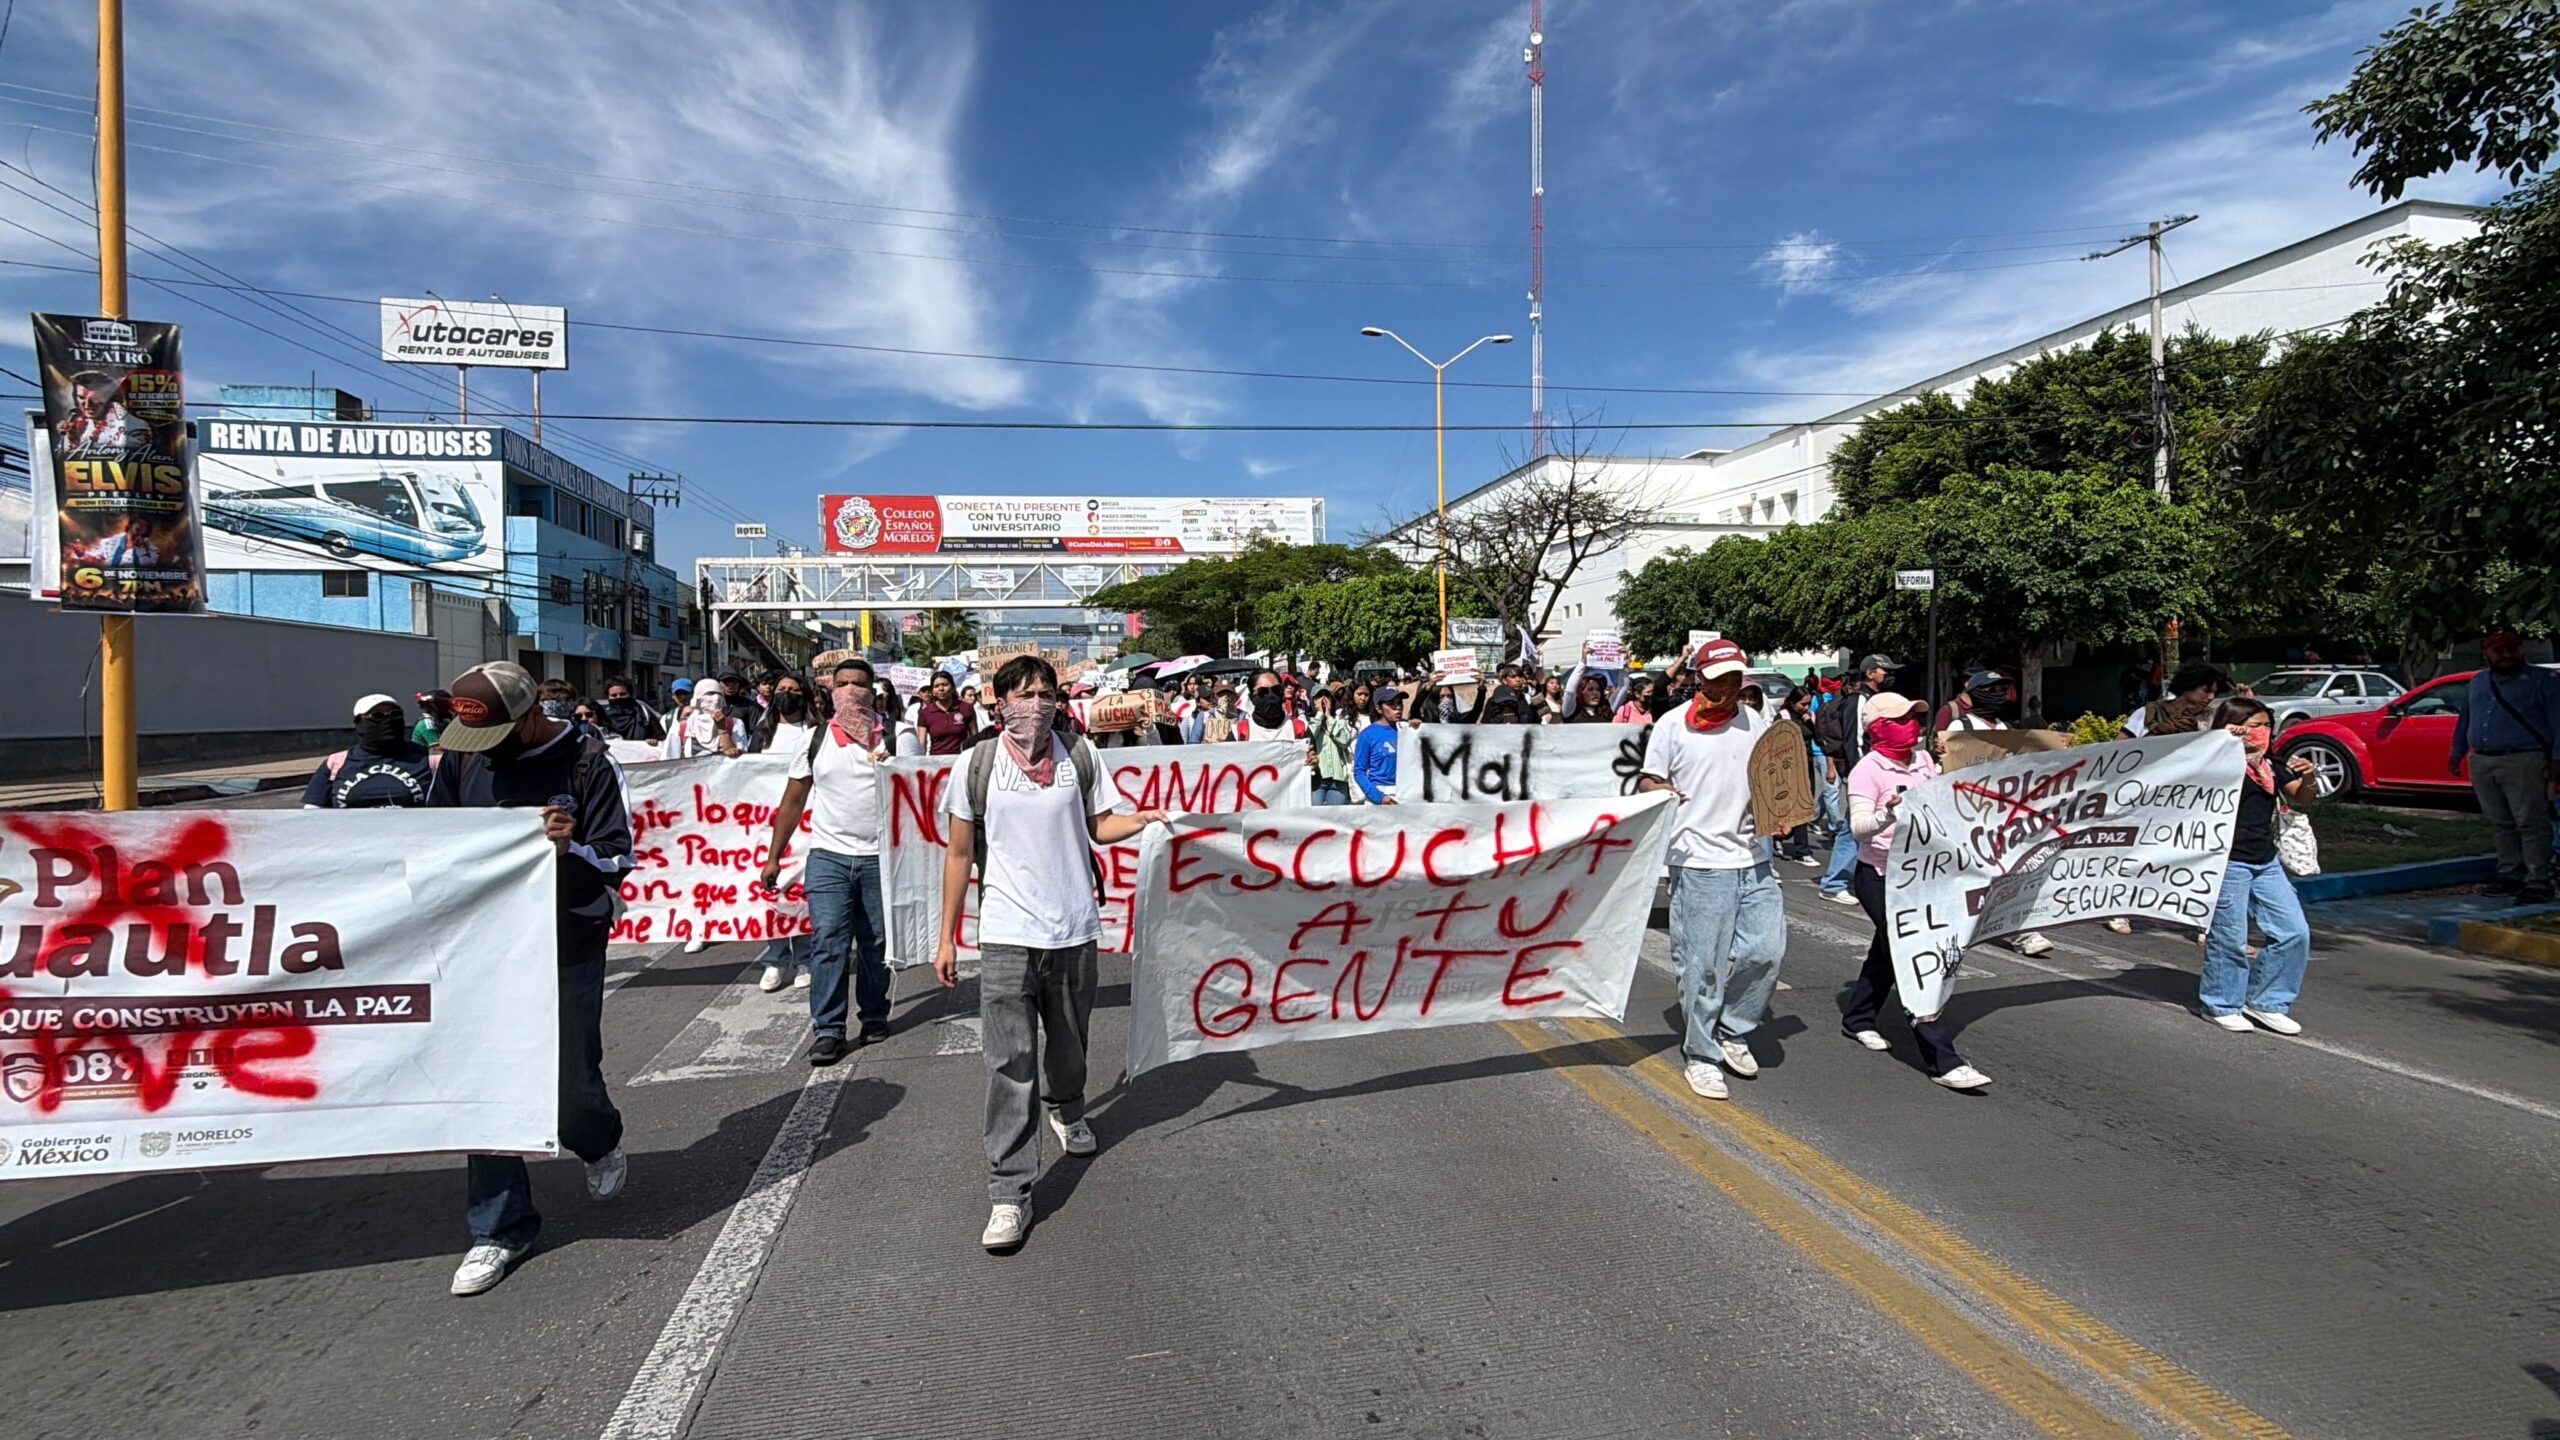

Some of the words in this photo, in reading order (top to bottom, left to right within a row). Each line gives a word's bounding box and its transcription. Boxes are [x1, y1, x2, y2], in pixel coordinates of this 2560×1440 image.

[68, 347, 153, 365] TEATRO
[397, 345, 443, 357] RENTA
[446, 346, 464, 357] DE
[467, 346, 550, 361] AUTOBUSES
[128, 374, 178, 393] 15%
[210, 422, 296, 452] RENTA
[300, 426, 334, 454] DE
[339, 427, 492, 458] AUTOBUSES
[64, 461, 184, 495] ELVIS
[87, 491, 165, 500] PRESLEY
[946, 502, 1002, 511] CONECTA
[1006, 503, 1020, 511] TU
[1024, 503, 1081, 512] PRESENTE
[882, 507, 935, 520] COLEGIO
[885, 519, 935, 531] ESPAÑOL
[968, 512, 994, 521] CON
[996, 513, 1012, 521] TU
[1015, 513, 1062, 521] FUTURO
[736, 526, 765, 535] HOTEL
[882, 532, 935, 543] MORELOS
[972, 523, 1061, 532] UNIVERSITARIO
[74, 567, 104, 589] 6
[118, 570, 189, 581] NOVIEMBRE
[1897, 575, 1931, 585] REFORMA
[980, 660, 993, 671] NO
[1108, 695, 1124, 706] LA
[1098, 707, 1137, 722] LUCHA
[1419, 729, 1533, 802] Mal
[2087, 749, 2144, 782] NO
[336, 771, 369, 808] VILLA
[368, 763, 425, 803] CELESTE
[1996, 769, 2079, 814] Plan
[2114, 779, 2240, 815] QUEREMOS
[1903, 804, 1948, 854] NO
[2096, 831, 2127, 844] PAZ
[2138, 816, 2228, 853] LONAS
[1168, 802, 1633, 893] ESCUCHA
[29, 844, 245, 909] Plan
[2050, 855, 2219, 895] QUEREMOS
[693, 882, 738, 916] que
[2050, 883, 2211, 919] SEGURIDAD
[666, 908, 692, 941] la
[703, 909, 813, 941] revoluc
[1288, 901, 1372, 950] A
[1416, 888, 1572, 940] TU
[1895, 903, 1950, 939] EL
[1192, 934, 1583, 1038] GENTE
[0, 1007, 62, 1033] QUE
[72, 1000, 294, 1030] CONSTRUYEN
[304, 998, 346, 1018] LA
[355, 995, 413, 1016] PAZ
[60, 1052, 139, 1083] 089
[21, 1136, 92, 1148] Gobierno
[96, 1134, 112, 1145] de
[176, 1127, 253, 1143] MORELOS
[16, 1145, 109, 1167] México
